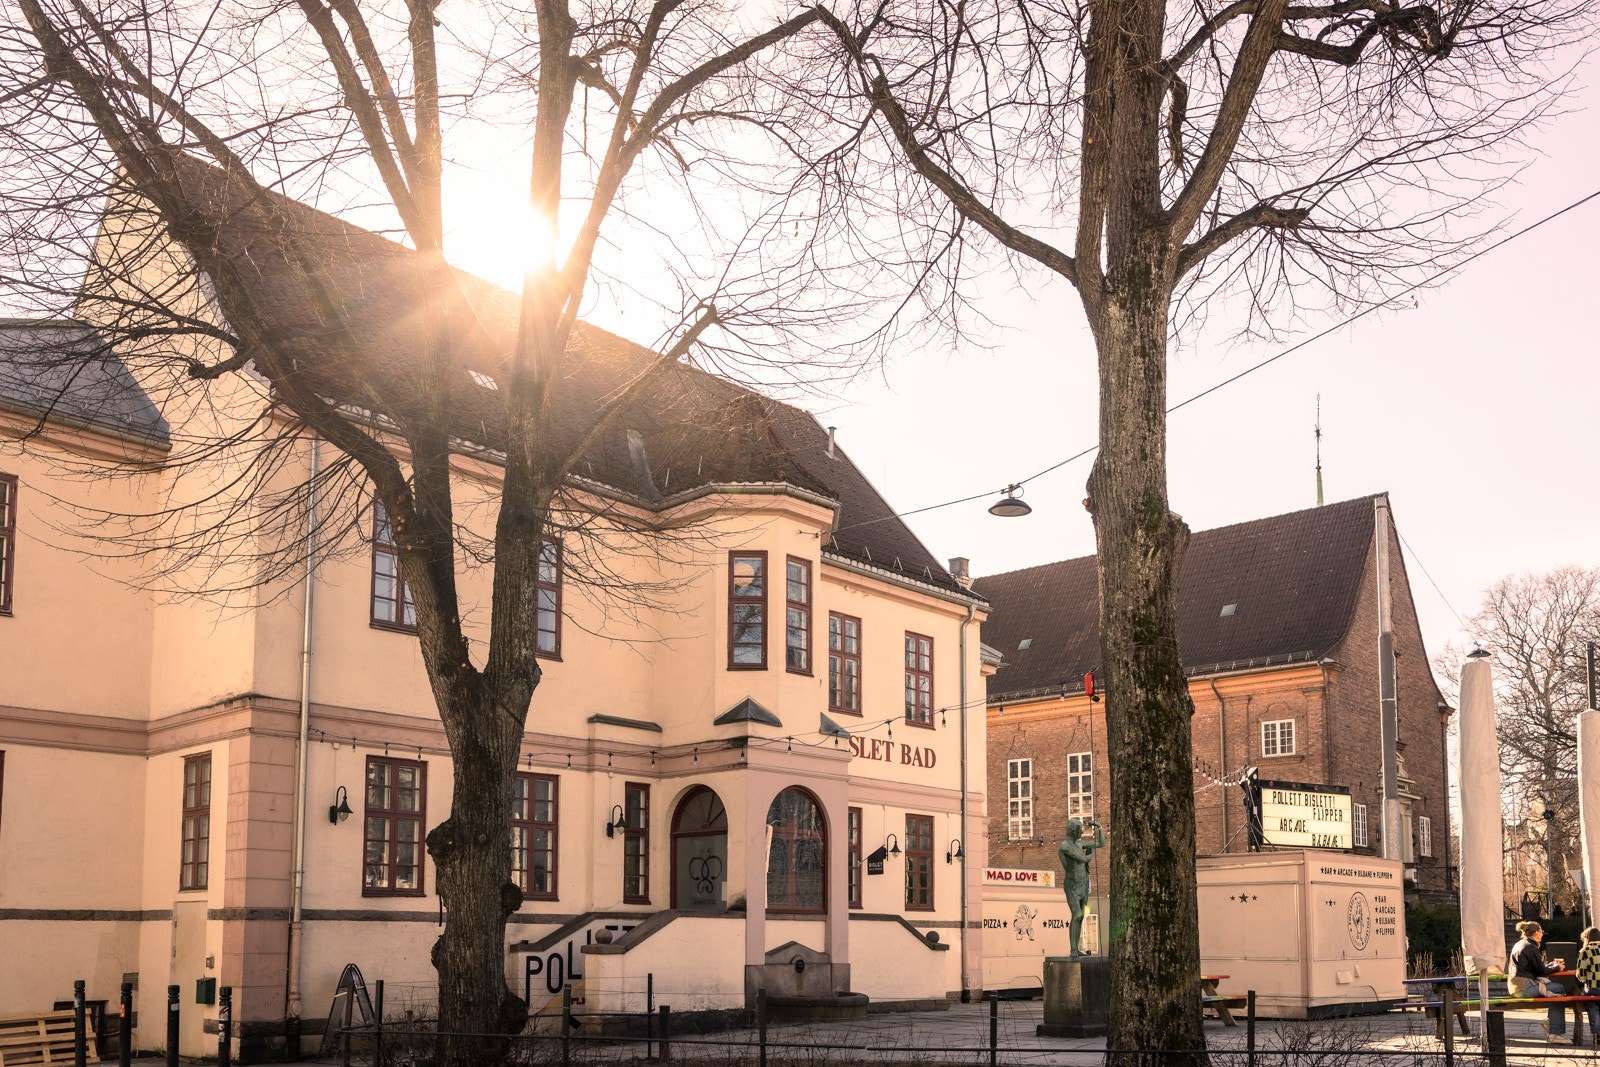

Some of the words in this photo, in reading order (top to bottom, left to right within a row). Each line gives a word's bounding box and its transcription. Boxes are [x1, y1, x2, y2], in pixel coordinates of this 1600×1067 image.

[900, 743, 937, 769] BAD
[1312, 807, 1343, 821] FLIPPER
[986, 870, 1012, 881] MAD
[1015, 871, 1038, 882] LOVE
[1324, 867, 1332, 875] BAR
[1337, 868, 1353, 876] ARCADE
[1378, 895, 1387, 903] BAR
[1379, 906, 1396, 914] ARCADE
[983, 919, 1002, 929] PIZZA
[1048, 919, 1065, 929] PIZZA
[1379, 928, 1395, 936] FLIPPER
